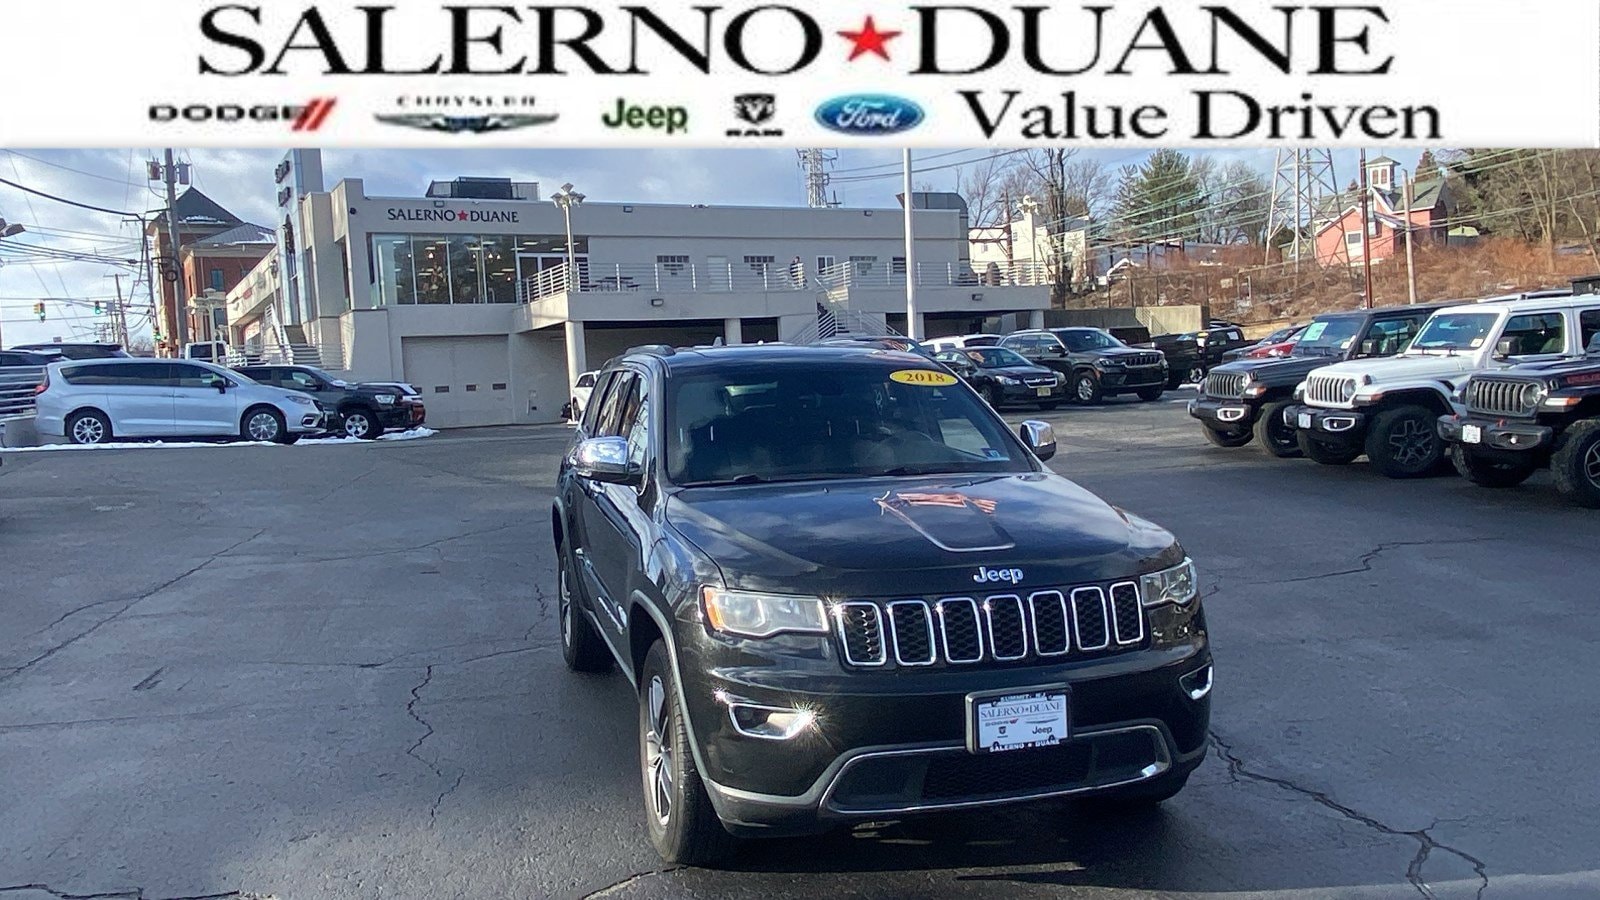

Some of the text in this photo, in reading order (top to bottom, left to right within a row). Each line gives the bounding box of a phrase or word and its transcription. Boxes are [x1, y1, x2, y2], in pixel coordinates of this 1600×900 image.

[387, 208, 520, 223] SALERNO DUANE
[903, 372, 945, 383] 2018
[973, 566, 1024, 584] Jeep
[981, 705, 1025, 718] SALERNO
[1029, 702, 1063, 713] DUANE
[1032, 726, 1052, 735] Jeep
[989, 743, 1025, 752] SALERNO
